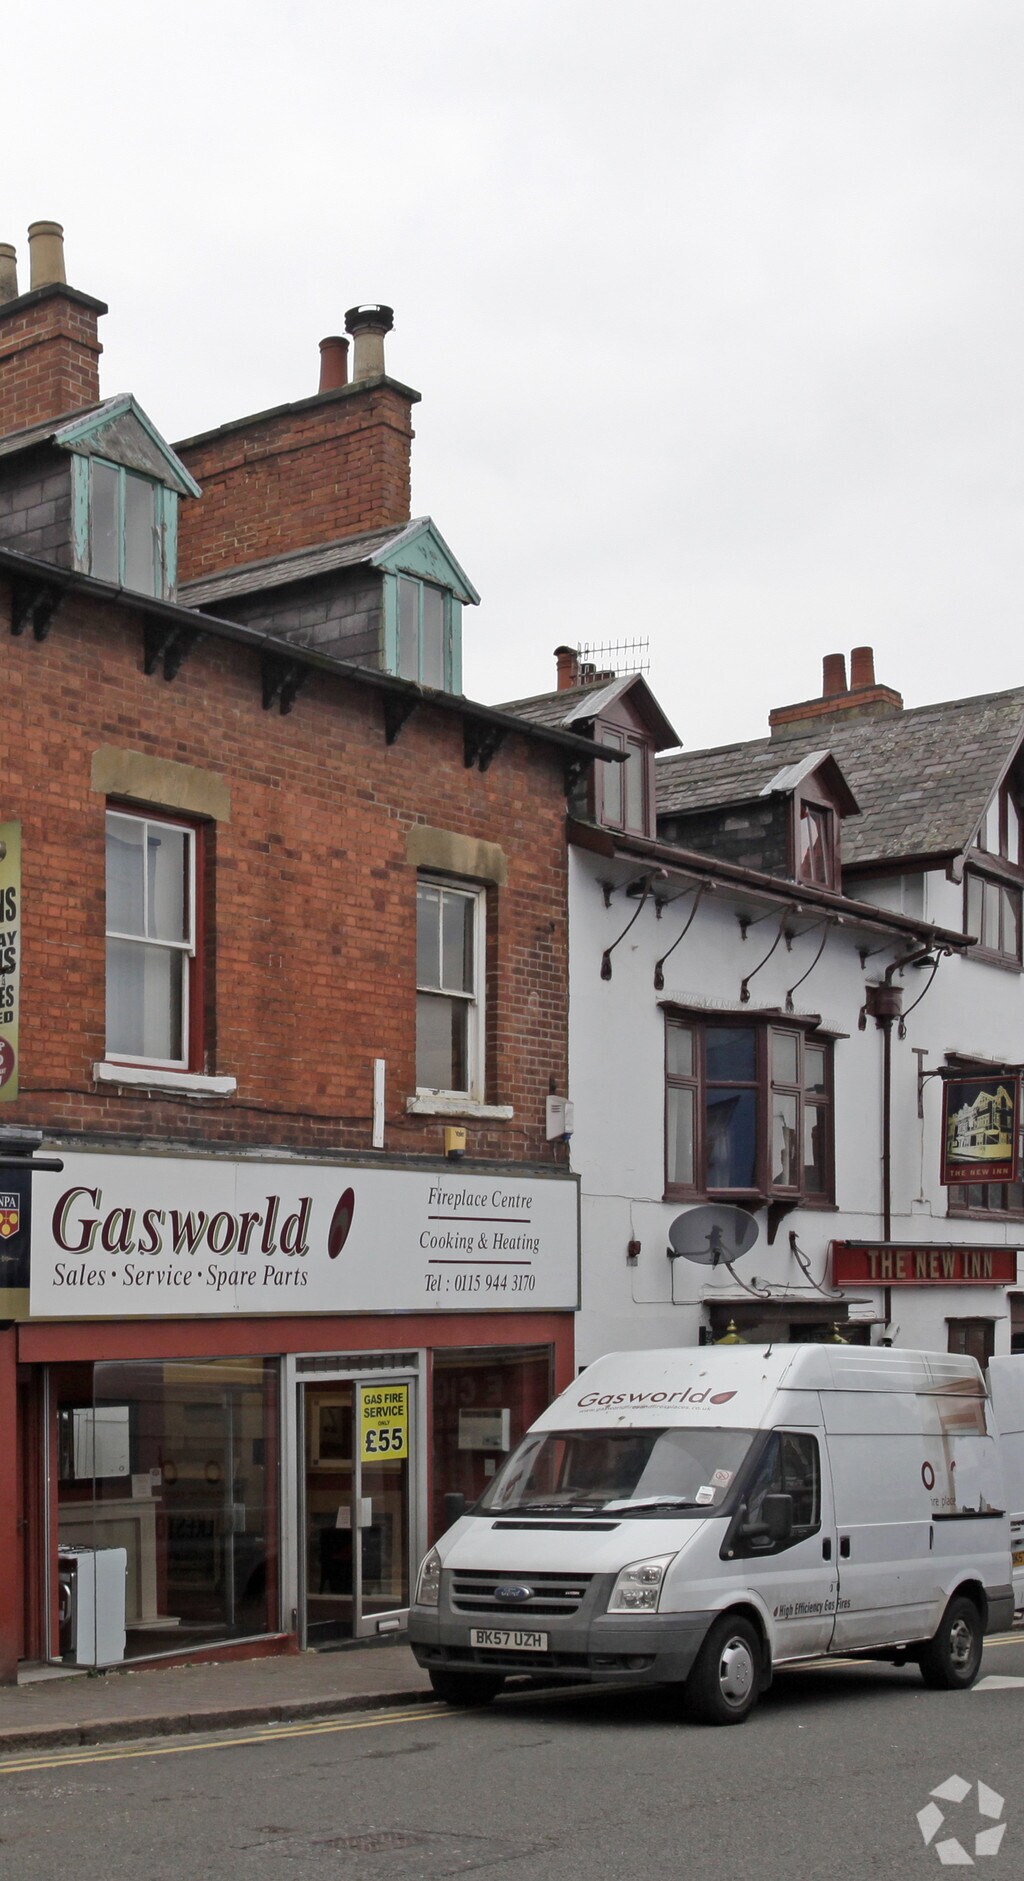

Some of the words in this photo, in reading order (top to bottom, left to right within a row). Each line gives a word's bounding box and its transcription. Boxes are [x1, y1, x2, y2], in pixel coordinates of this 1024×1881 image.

[970, 1169, 988, 1177] NEW
[992, 1167, 1009, 1175] INN
[428, 1187, 488, 1210] Fireplace
[491, 1190, 533, 1209] Centre
[52, 1186, 313, 1257] Gasworld
[419, 1230, 474, 1253] Cooking
[477, 1232, 488, 1249] &
[492, 1232, 540, 1254] Heating
[867, 1250, 906, 1279] THE
[915, 1250, 955, 1279] NEW
[962, 1250, 993, 1278] INN
[53, 1263, 107, 1287] Sales
[123, 1264, 192, 1287] Service
[206, 1264, 257, 1291] Spare
[262, 1265, 308, 1287] Parts
[454, 1274, 481, 1292] 0115
[485, 1274, 507, 1292] 944
[511, 1274, 536, 1292] 3170
[364, 1393, 383, 1405] GAS
[384, 1392, 403, 1404] FIRE
[577, 1387, 712, 1407] Gasworld
[364, 1405, 404, 1418] SERVICE
[365, 1427, 403, 1453] £55
[779, 1603, 793, 1619] High
[795, 1601, 824, 1615] Efficiency
[836, 1598, 851, 1610] Fires
[476, 1631, 511, 1646] BK57
[514, 1632, 542, 1648] UZH
